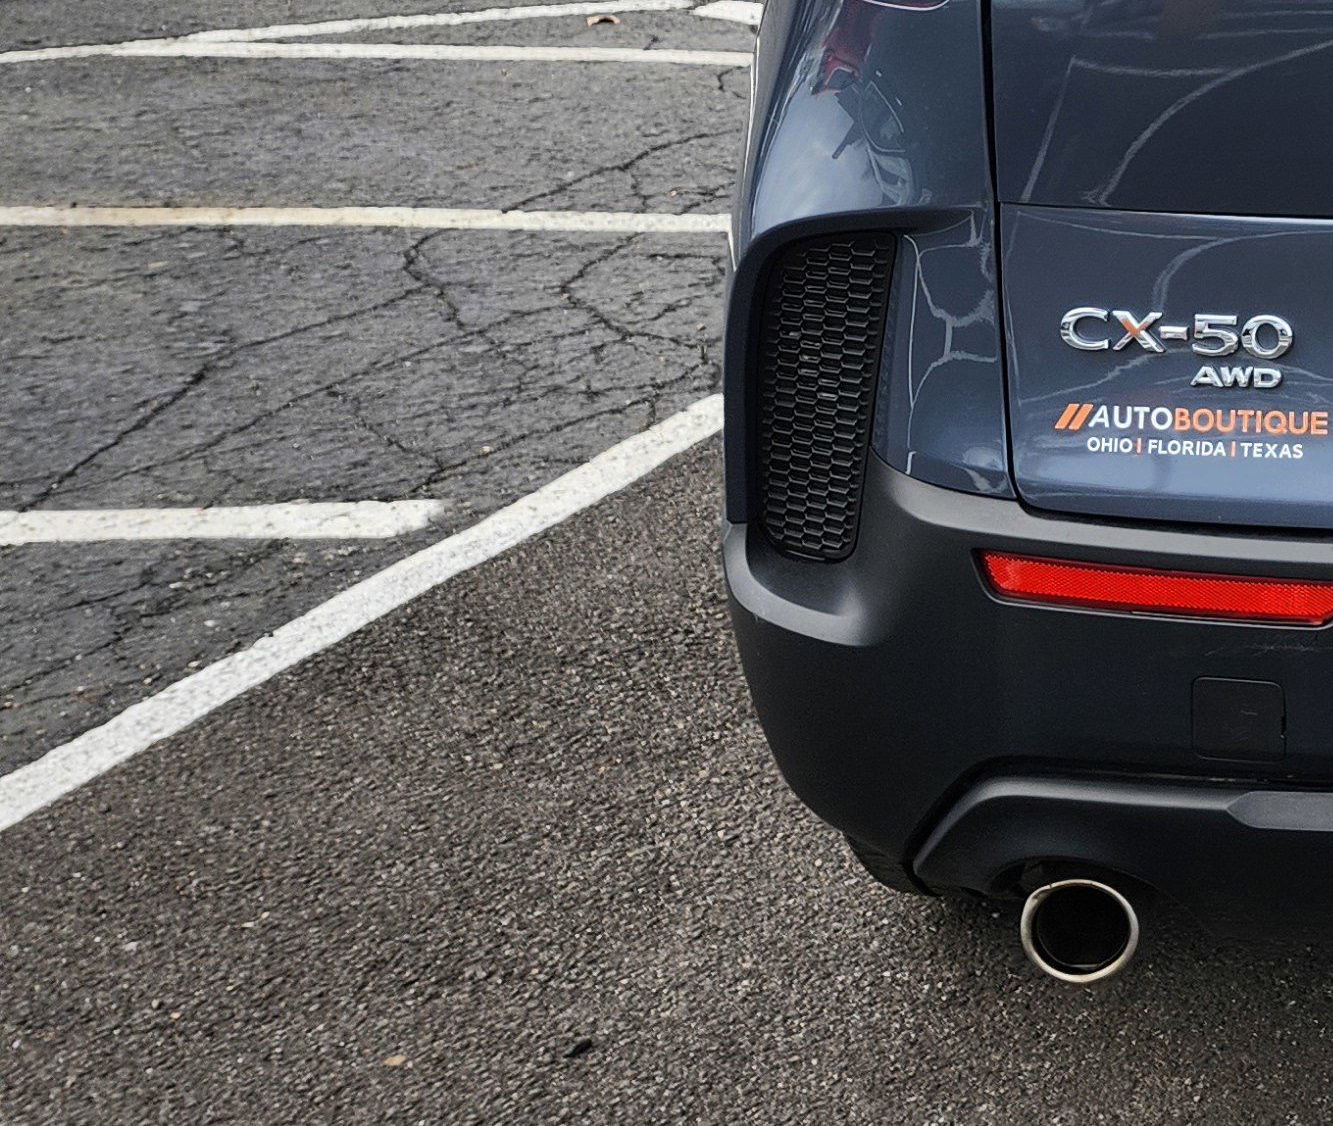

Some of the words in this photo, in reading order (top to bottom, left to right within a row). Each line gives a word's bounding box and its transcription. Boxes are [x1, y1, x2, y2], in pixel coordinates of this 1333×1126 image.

[1060, 306, 1294, 360] CX-50
[1190, 365, 1283, 389] AWD
[1088, 405, 1330, 436] AUTOBOUTIQUE
[1086, 436, 1133, 454] OHIO
[1148, 439, 1227, 457] FLORIDA
[1240, 441, 1305, 459] TEXAS
